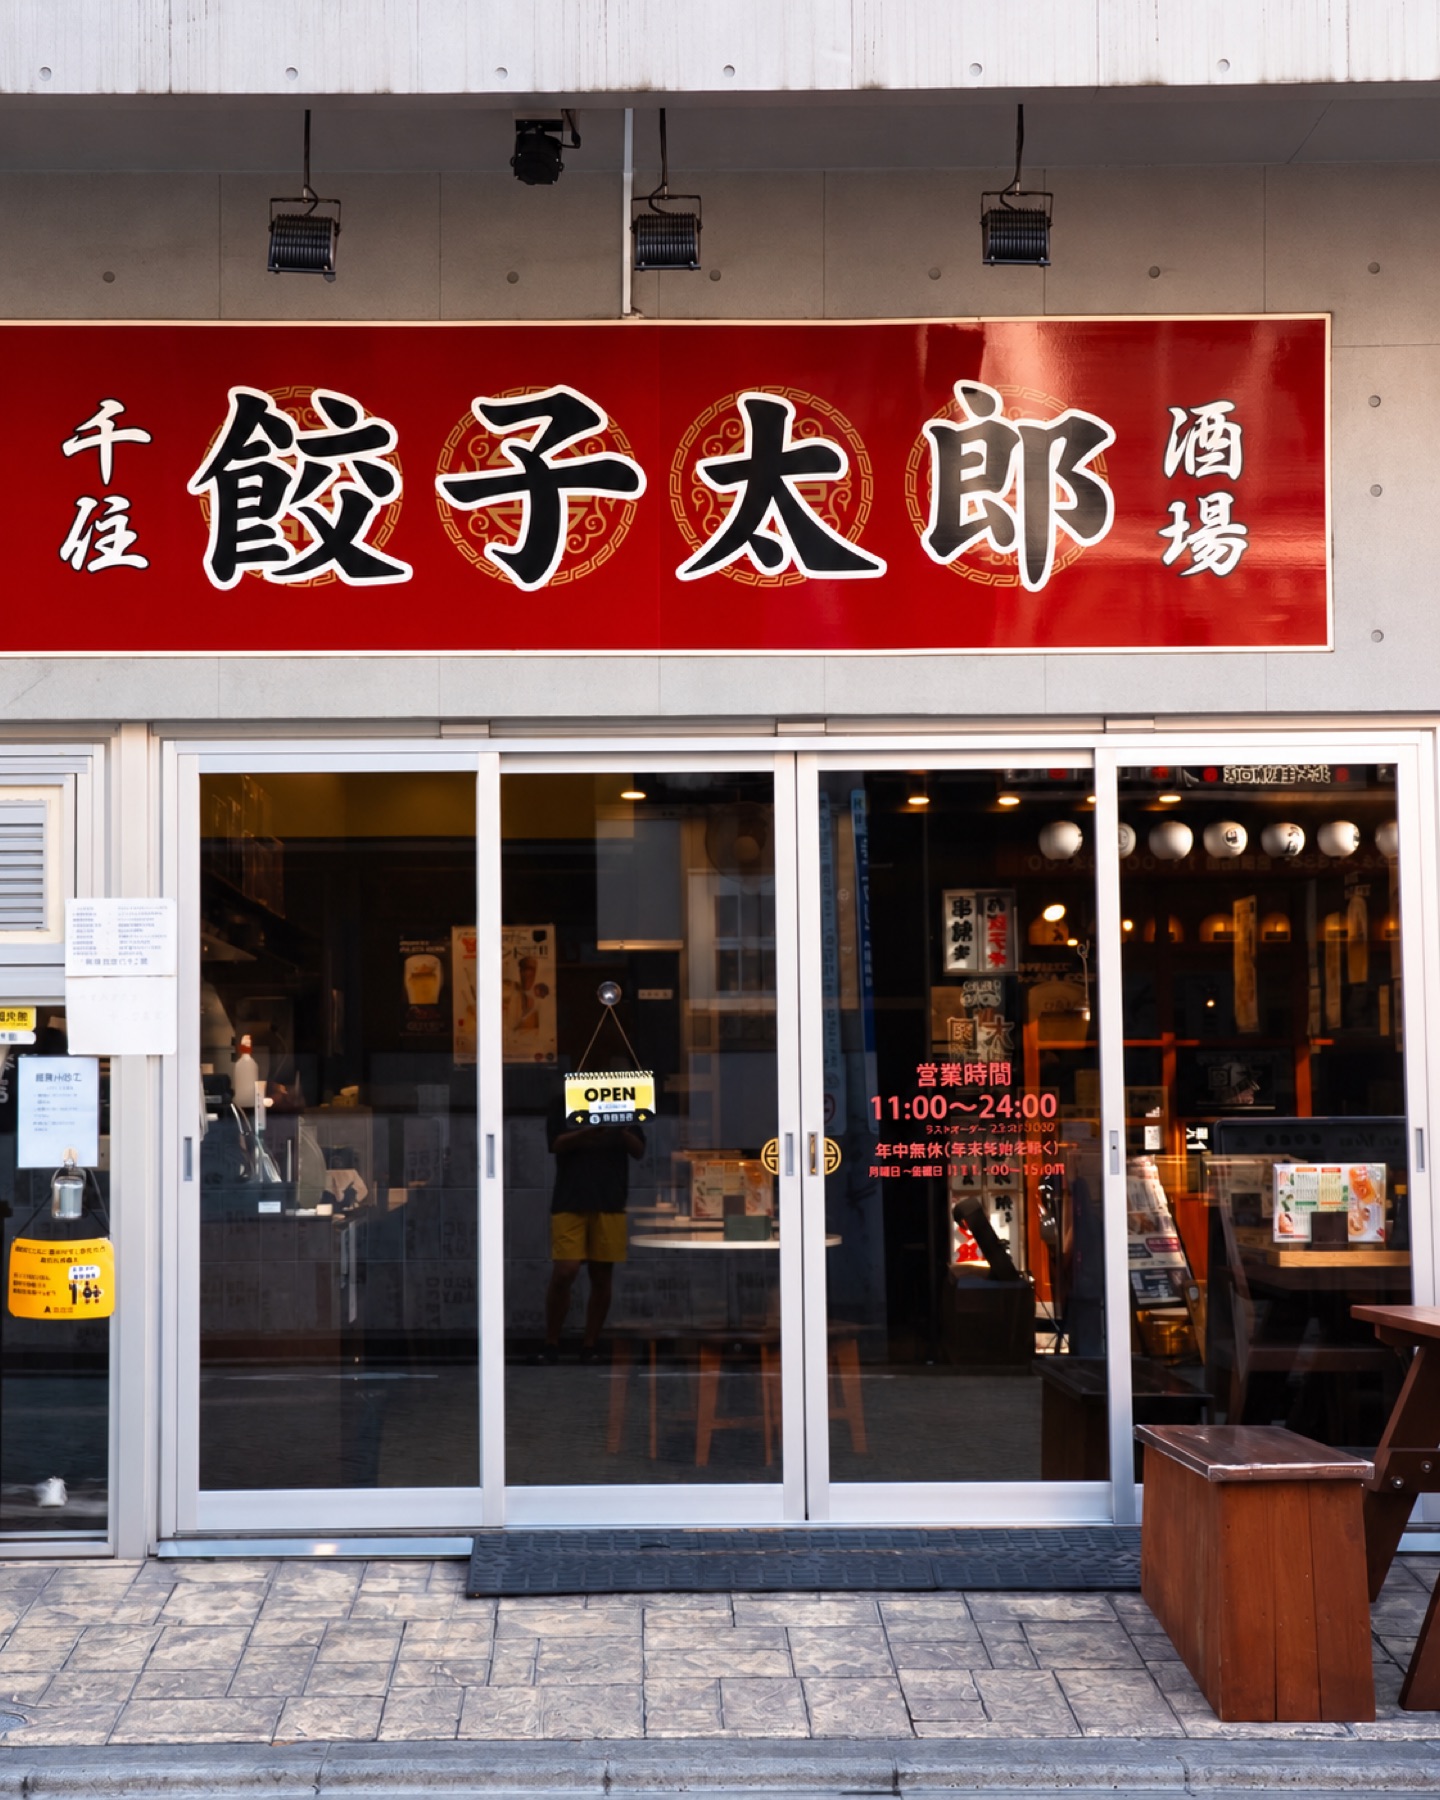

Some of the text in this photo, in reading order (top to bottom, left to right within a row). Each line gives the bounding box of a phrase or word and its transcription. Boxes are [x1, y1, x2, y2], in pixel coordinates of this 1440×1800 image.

[59, 398, 153, 574] 千住
[187, 379, 1116, 592] 餃子太郎
[1158, 399, 1250, 577] 酒場
[584, 1087, 636, 1102] OPEN
[916, 1062, 1011, 1087] 営業時間
